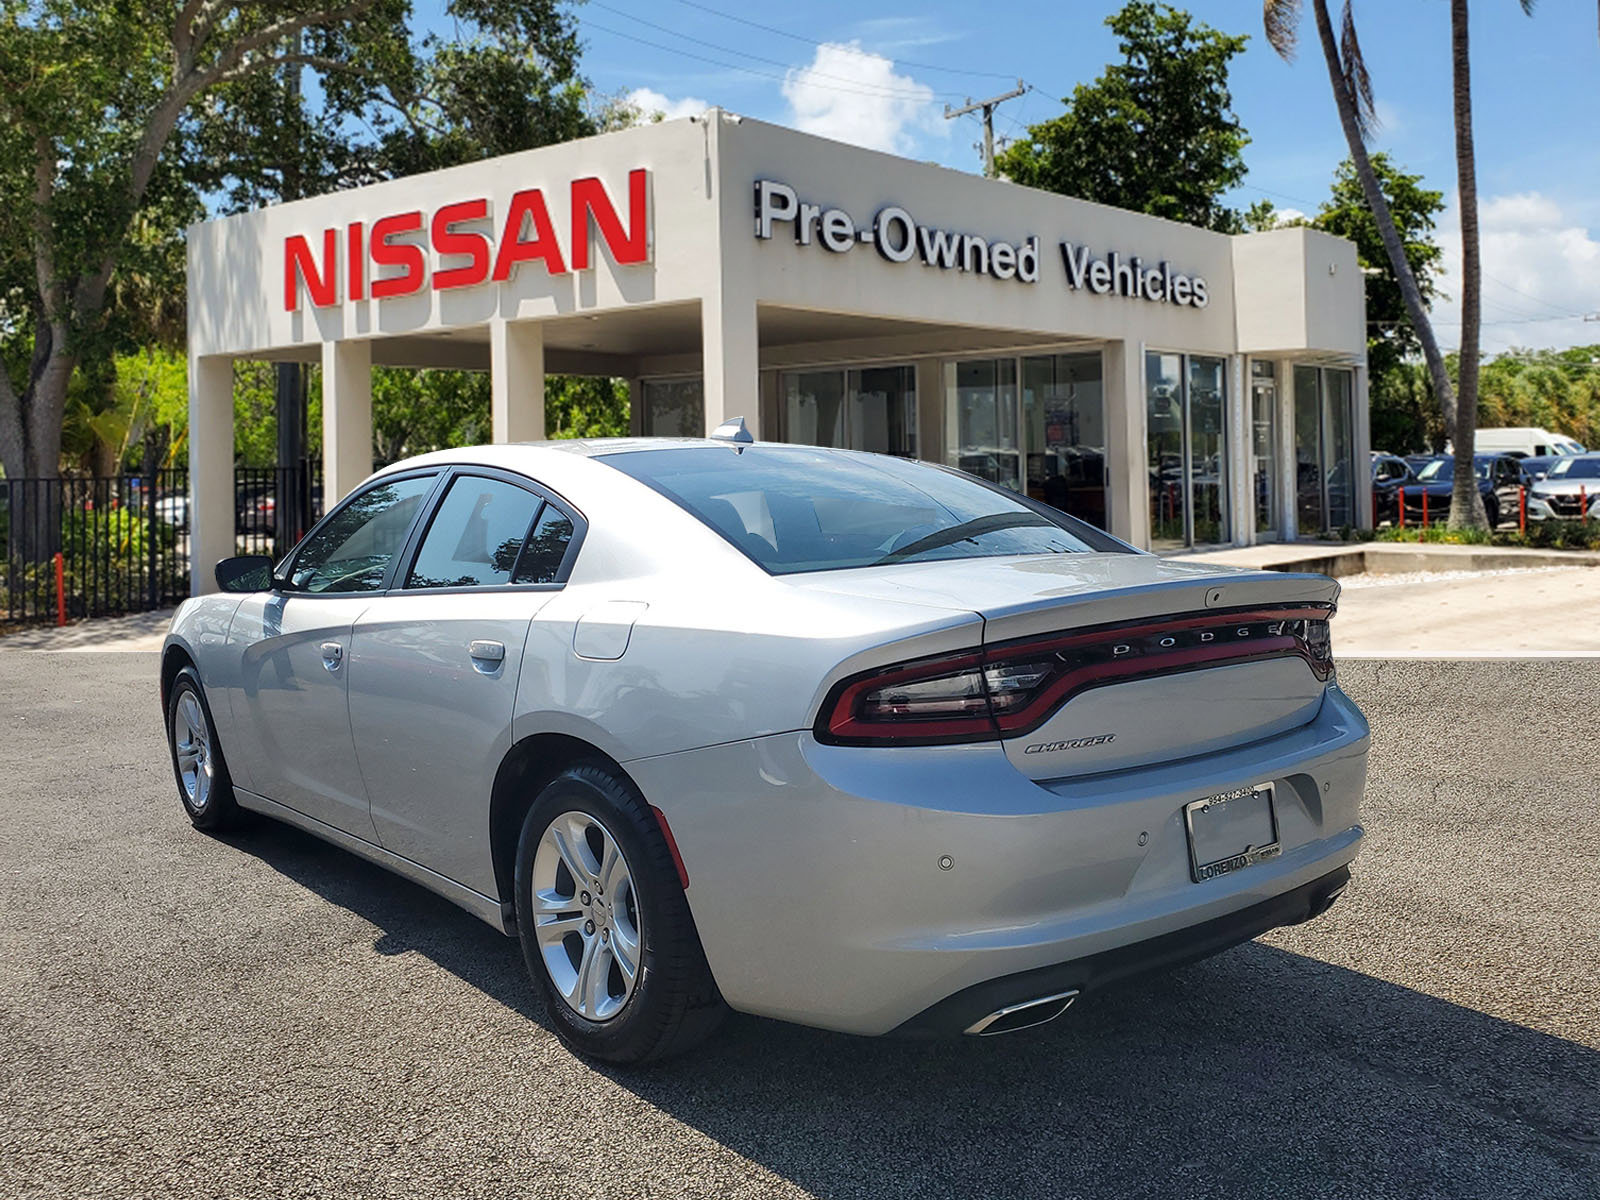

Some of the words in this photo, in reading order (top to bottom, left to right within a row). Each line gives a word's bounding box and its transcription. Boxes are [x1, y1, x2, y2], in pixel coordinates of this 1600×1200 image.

[284, 168, 650, 312] NISSAN
[754, 179, 1040, 284] Pre-Owned
[1060, 241, 1209, 308] Vehicles
[1113, 624, 1281, 653] DODGE
[1025, 733, 1117, 754] CHARGER
[1199, 855, 1247, 879] LORENZO
